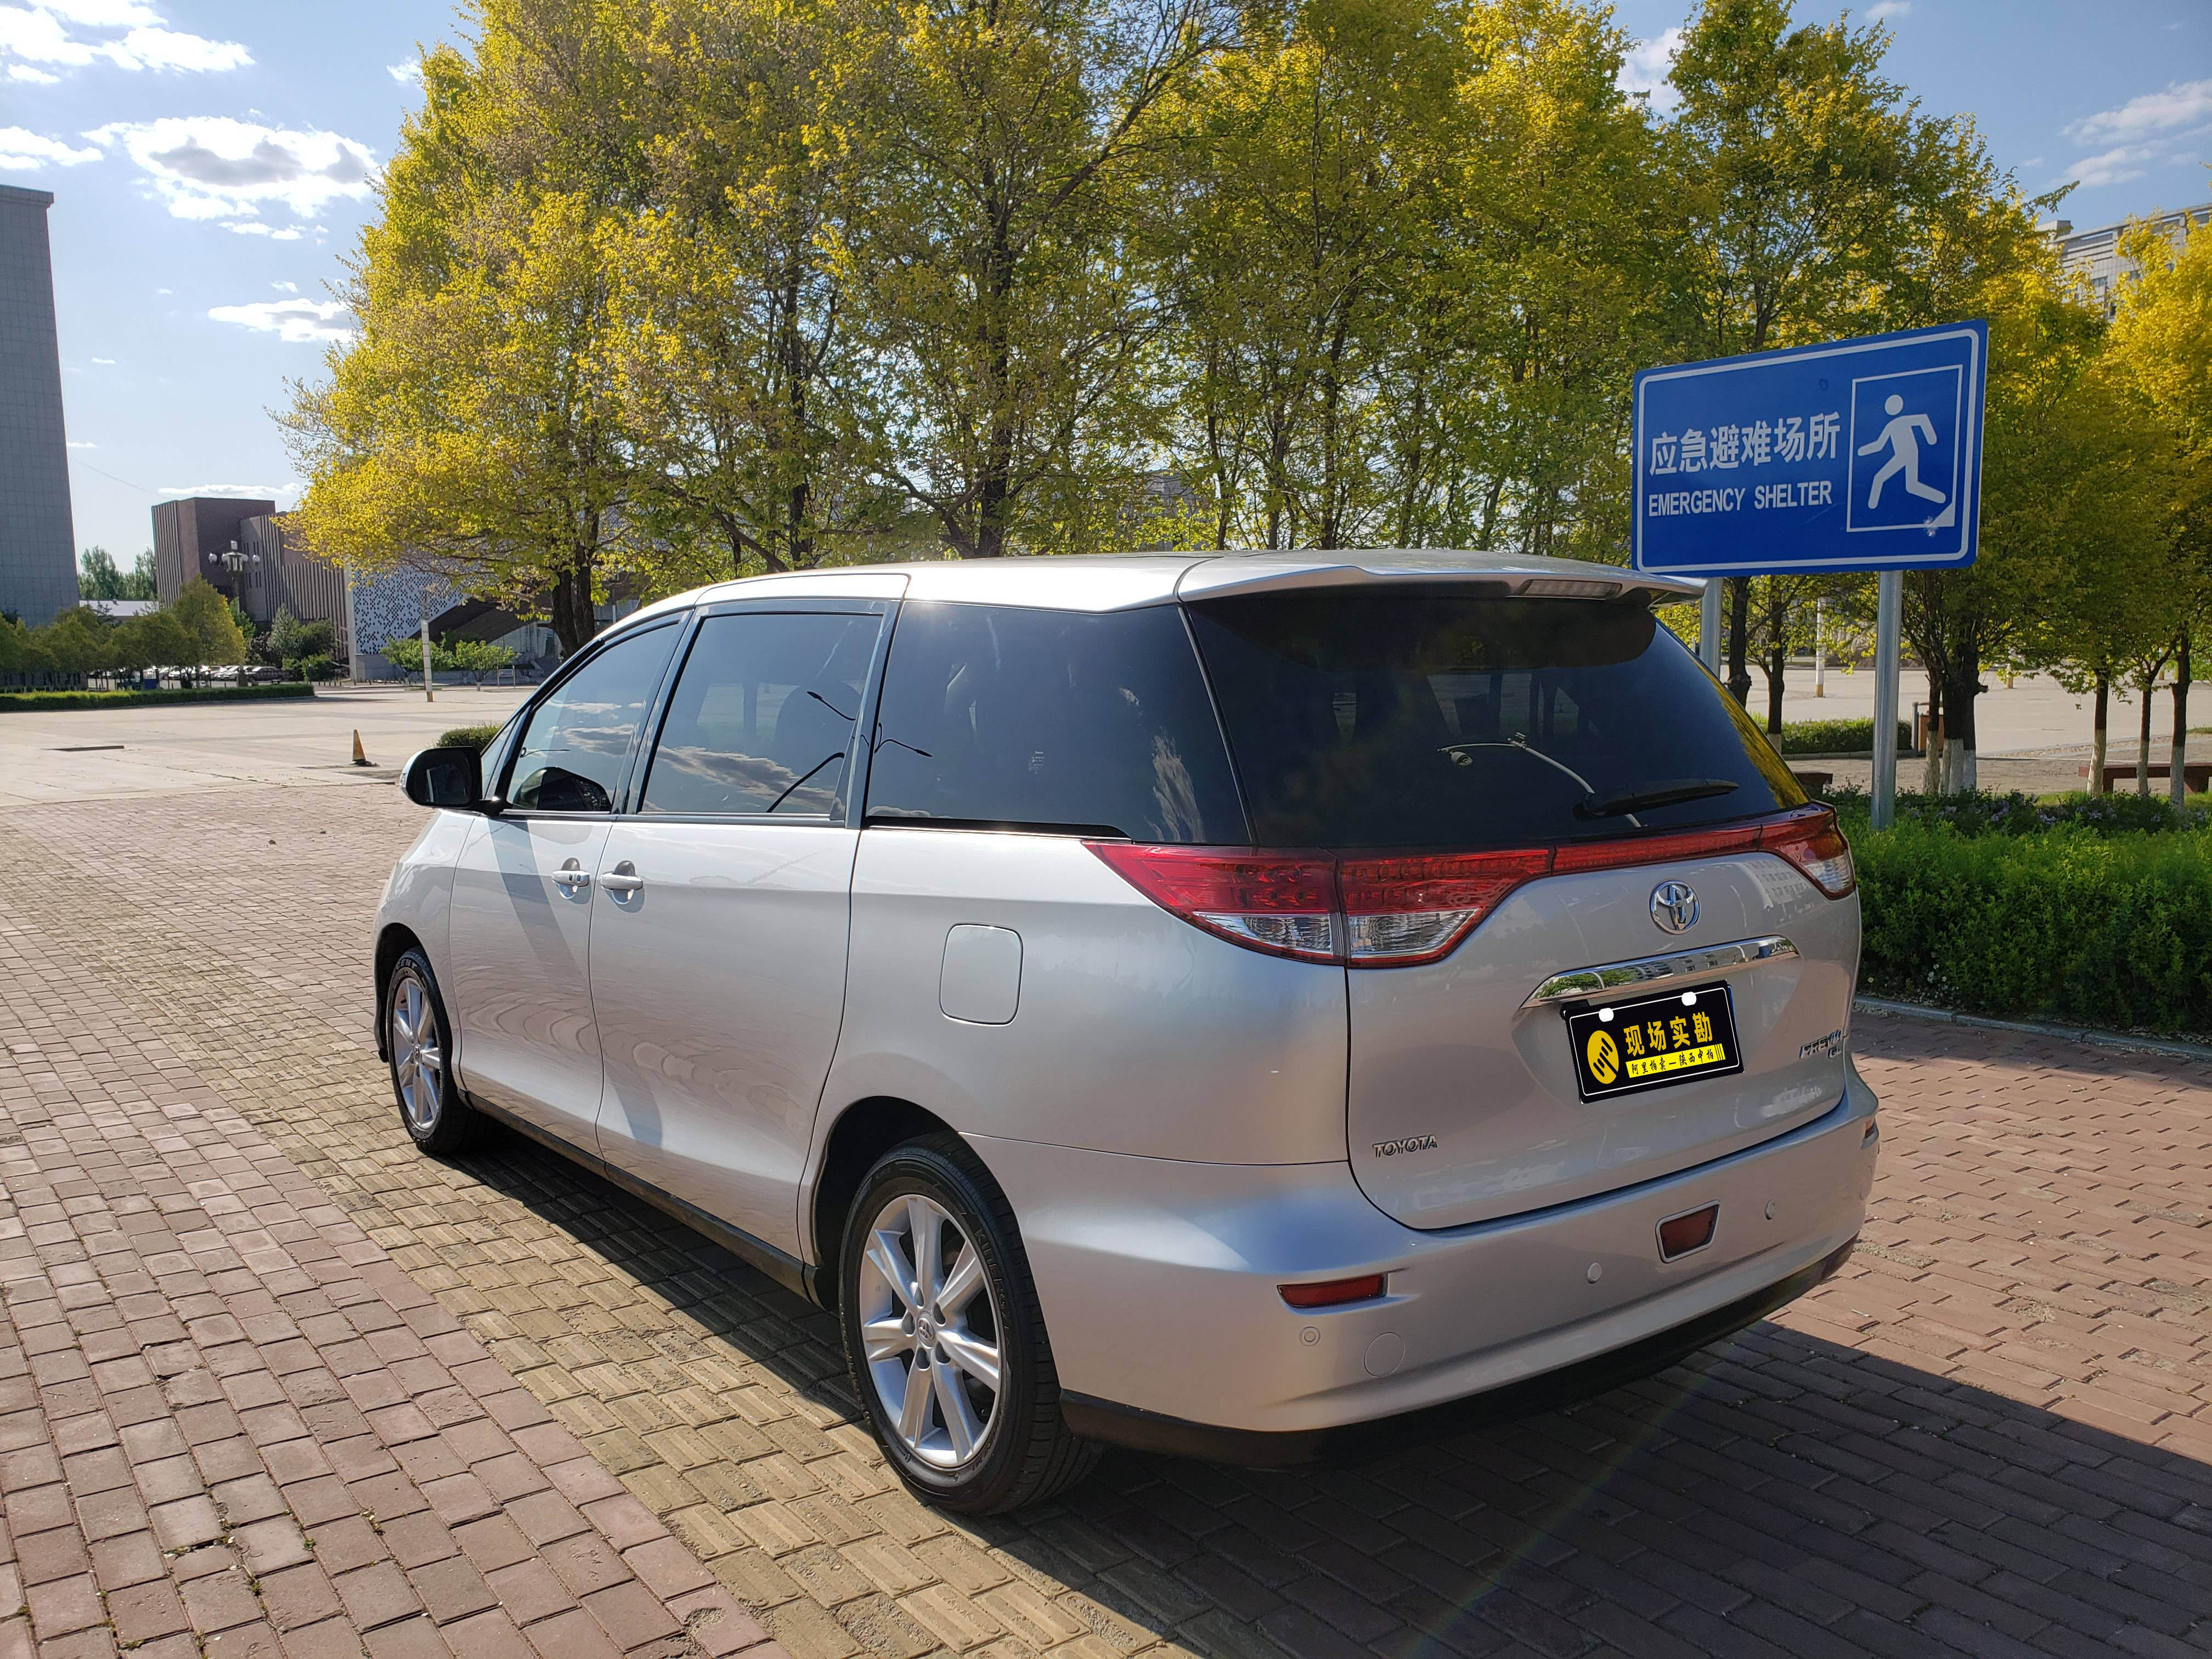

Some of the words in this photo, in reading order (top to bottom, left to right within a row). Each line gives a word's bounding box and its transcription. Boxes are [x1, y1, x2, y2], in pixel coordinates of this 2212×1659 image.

[1649, 411, 1841, 476] 应急避难场所
[1649, 488, 1746, 517] EMERGENCY
[1754, 481, 1832, 510] SHELTER
[1373, 1134, 1438, 1158] TOYOTA
